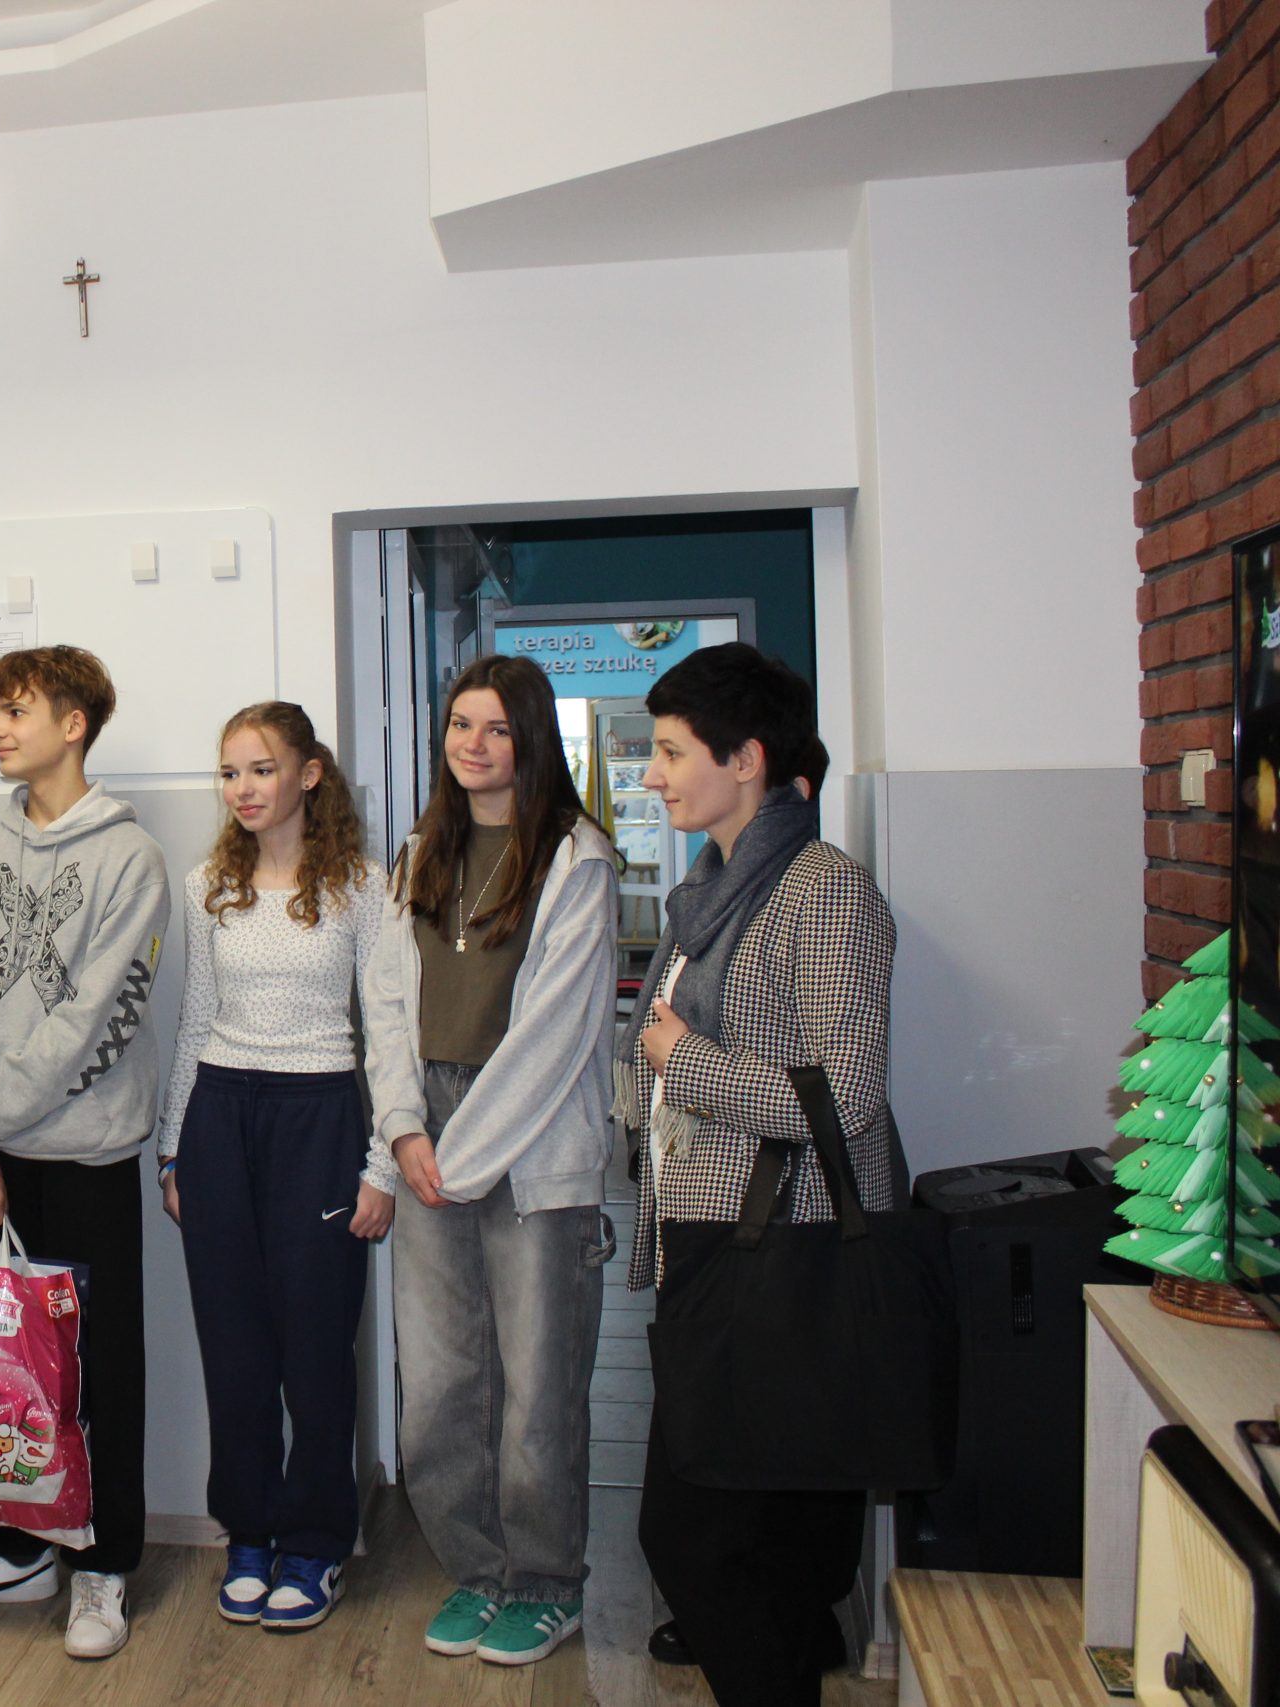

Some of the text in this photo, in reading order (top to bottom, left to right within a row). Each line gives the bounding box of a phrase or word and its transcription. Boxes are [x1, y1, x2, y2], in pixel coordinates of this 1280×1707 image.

[514, 631, 595, 655] terapia
[542, 651, 657, 675] zez sztukę
